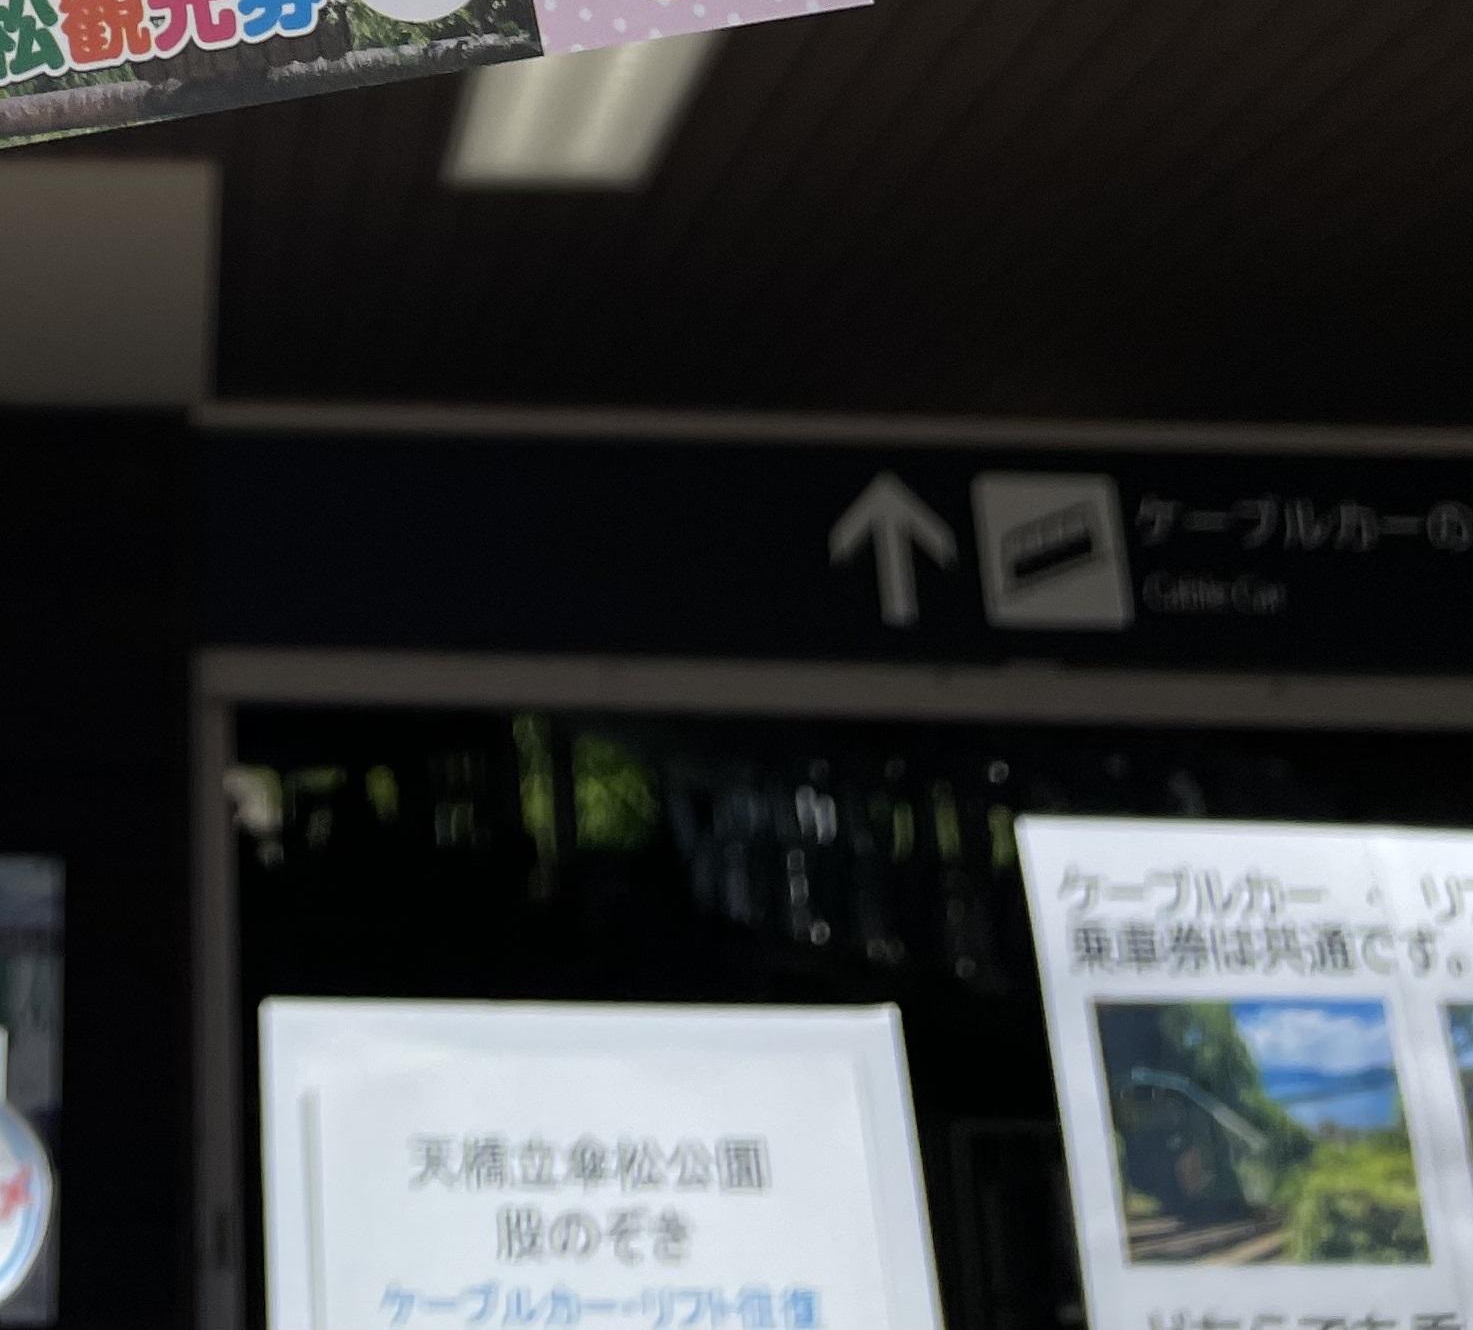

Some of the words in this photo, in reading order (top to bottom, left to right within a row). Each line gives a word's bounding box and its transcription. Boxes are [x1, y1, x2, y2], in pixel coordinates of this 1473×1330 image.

[408, 1132, 773, 1195] 天橋立傘松公園
[495, 1202, 695, 1266] 股のぞき
